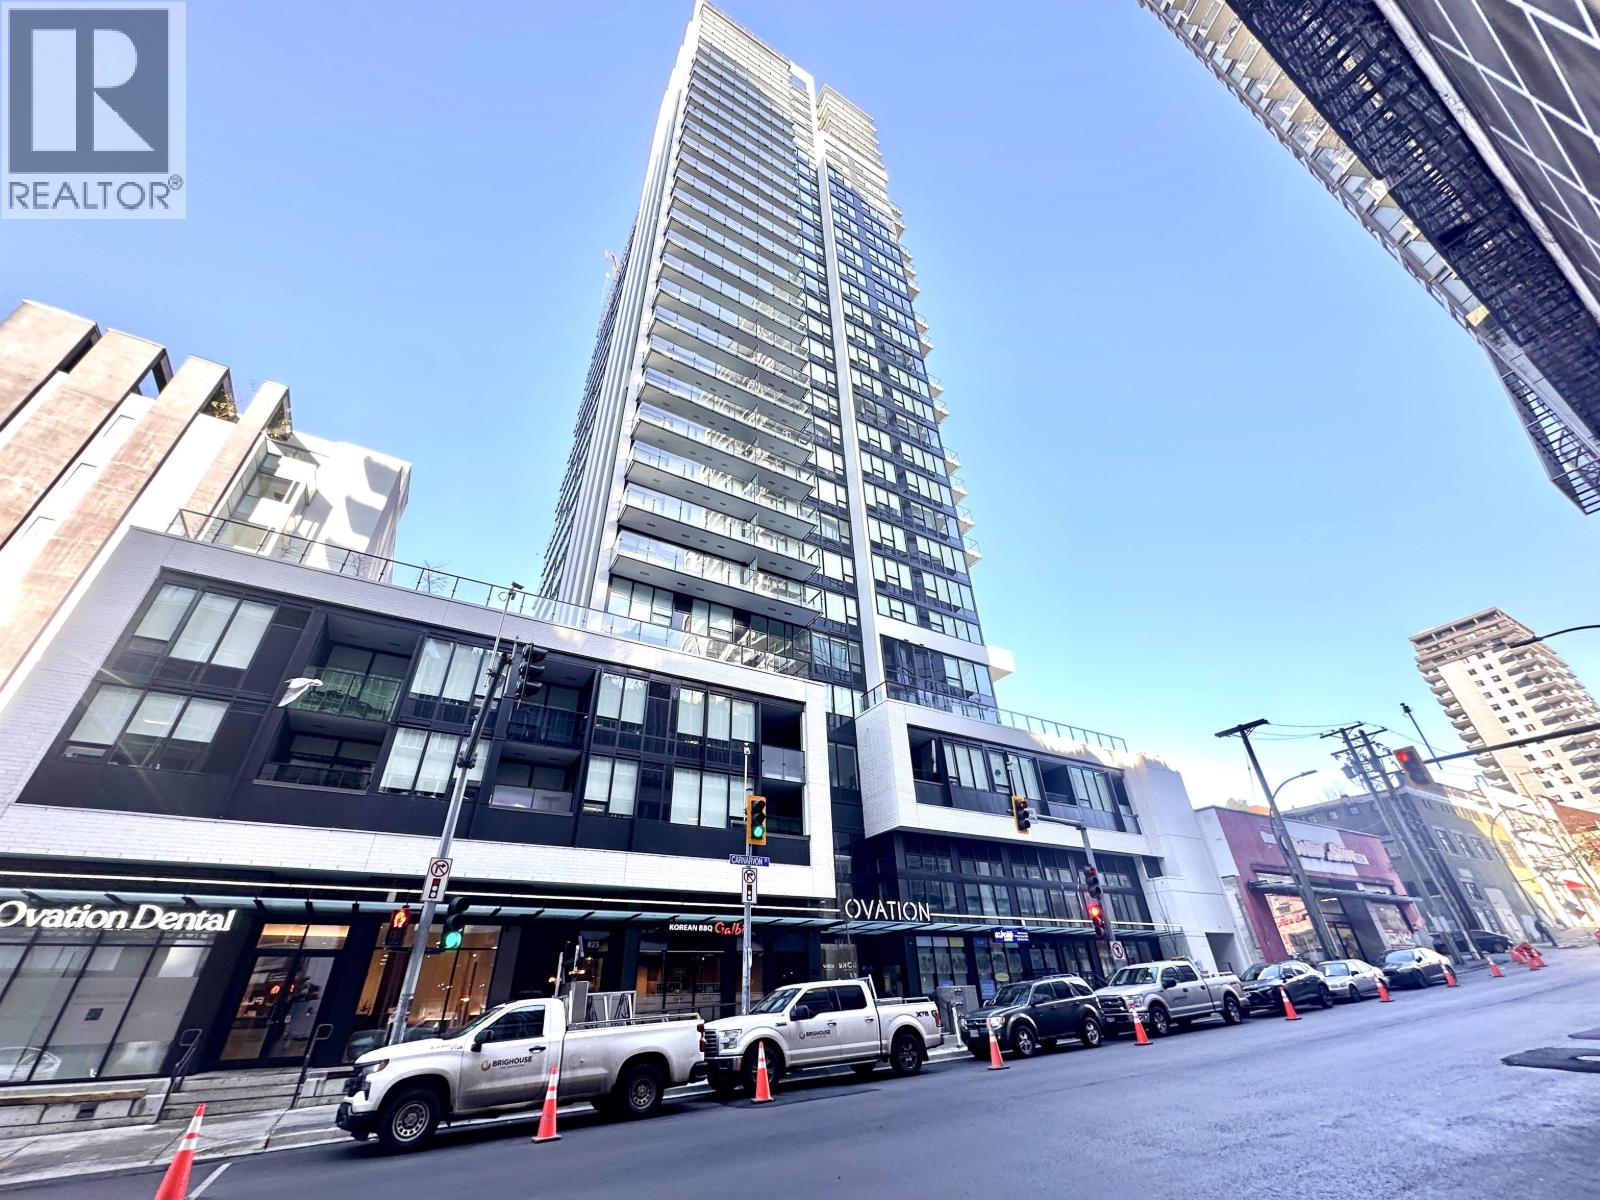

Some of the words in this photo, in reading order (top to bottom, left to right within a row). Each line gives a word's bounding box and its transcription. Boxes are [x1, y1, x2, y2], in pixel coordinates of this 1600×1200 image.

[731, 855, 763, 866] CARNARVON
[0, 900, 131, 929] Ovation
[130, 904, 237, 931] Dental
[844, 898, 931, 921] OVATION
[669, 923, 698, 931] KOREAN
[699, 925, 713, 933] BBQ
[492, 1055, 533, 1067] BRIGHOUSE
